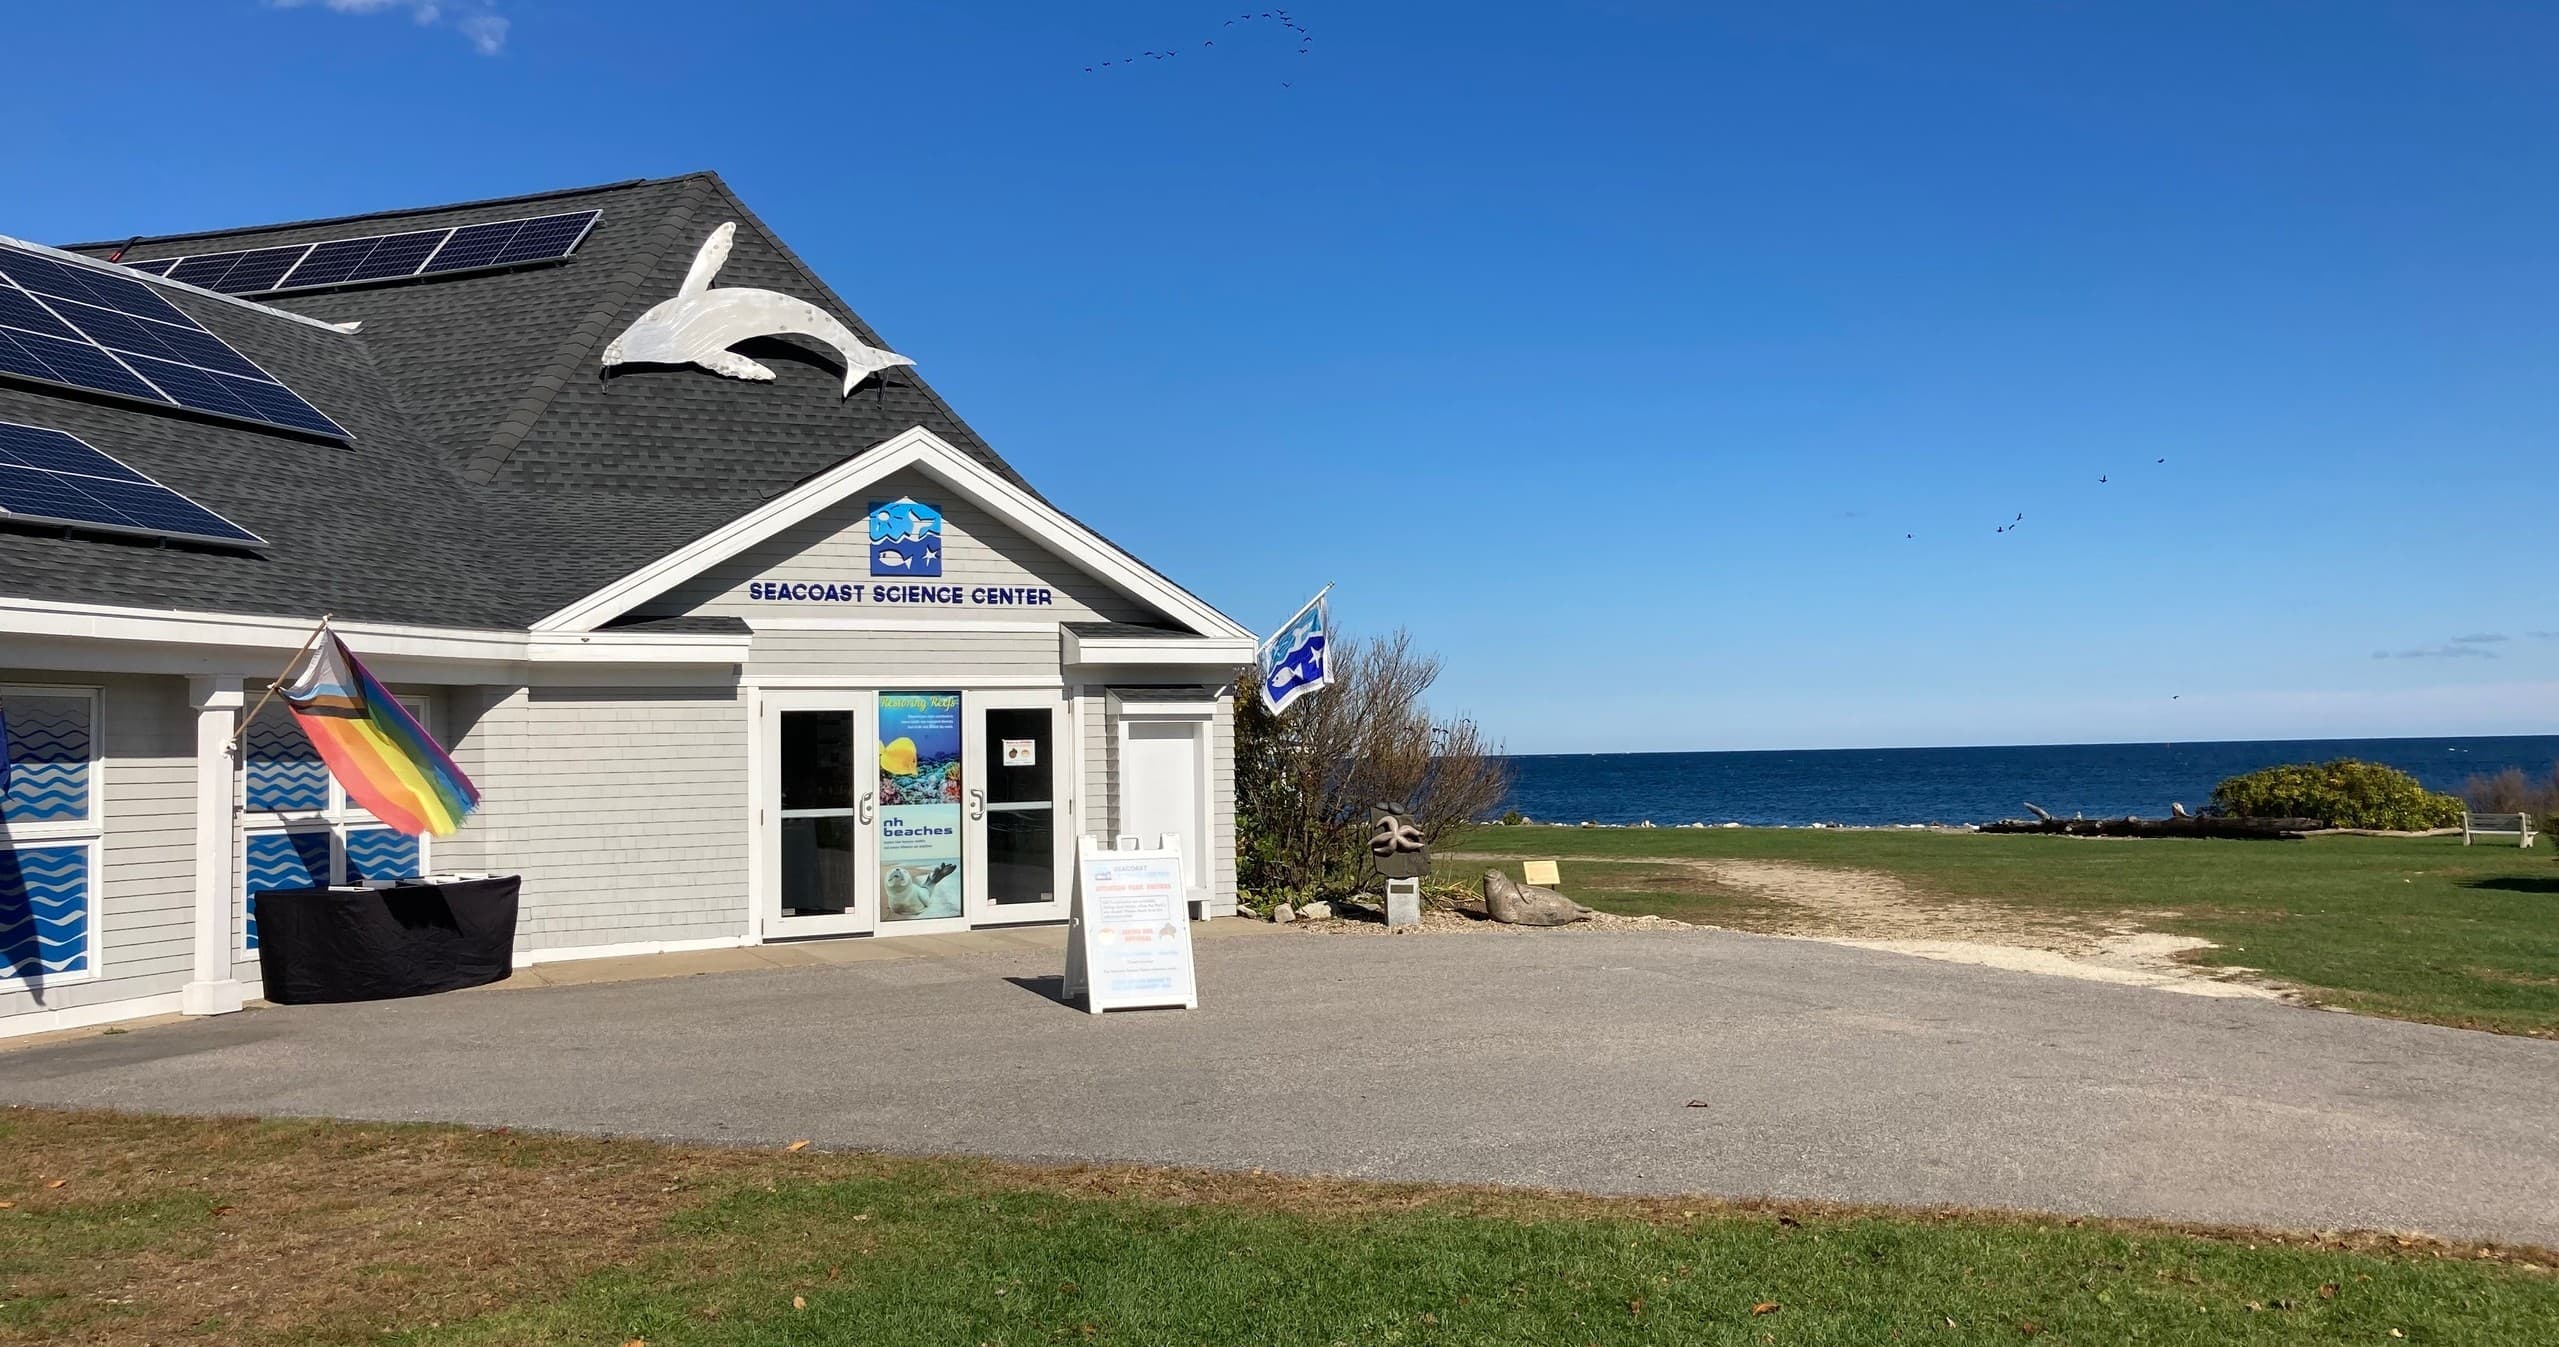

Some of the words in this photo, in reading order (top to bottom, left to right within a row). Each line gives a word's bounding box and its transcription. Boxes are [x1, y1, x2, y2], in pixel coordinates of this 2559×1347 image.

[749, 582, 865, 603] SEACOAST
[873, 584, 964, 605] SCIENCE
[971, 587, 1053, 606] CENTER
[883, 817, 903, 826] nh
[883, 826, 953, 837] beaches
